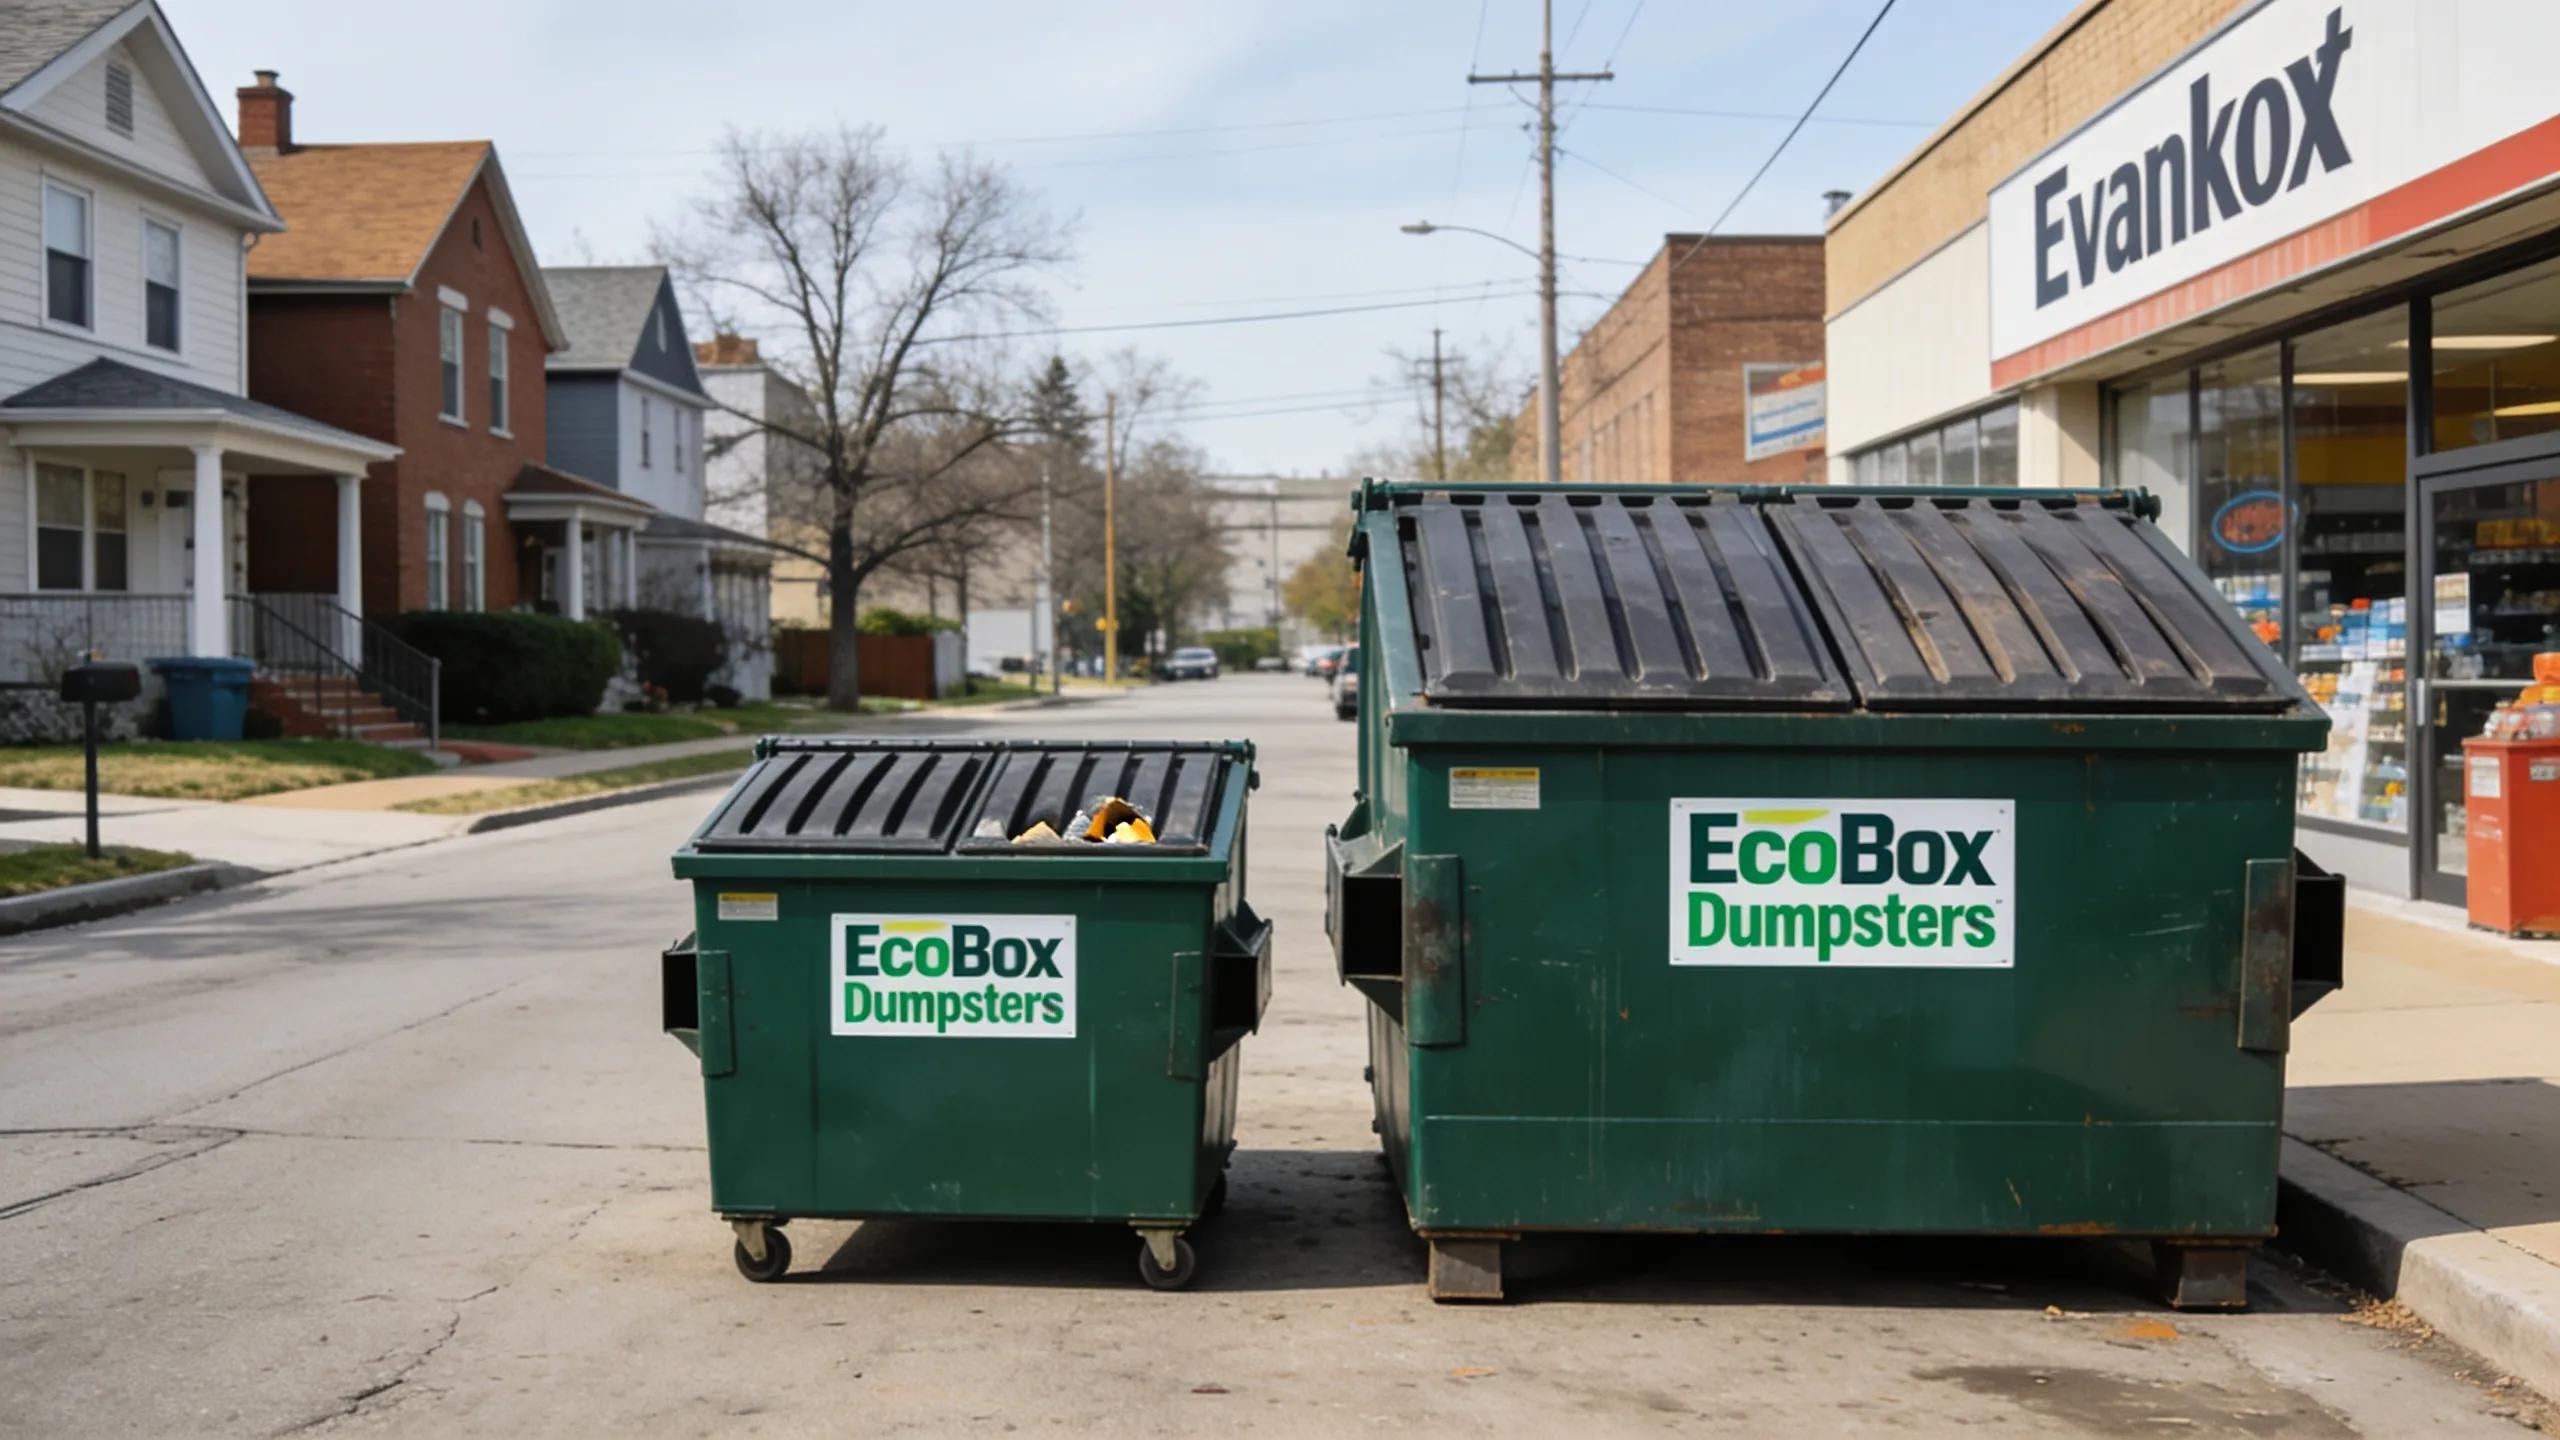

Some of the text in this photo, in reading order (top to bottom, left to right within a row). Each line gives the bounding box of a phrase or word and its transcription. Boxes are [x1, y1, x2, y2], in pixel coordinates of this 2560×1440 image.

[1690, 813, 1996, 885] EcoBox
[845, 925, 1063, 978] EcoBox
[1688, 891, 1995, 961] Dumpsters
[844, 982, 1063, 1033] Dumpsters
